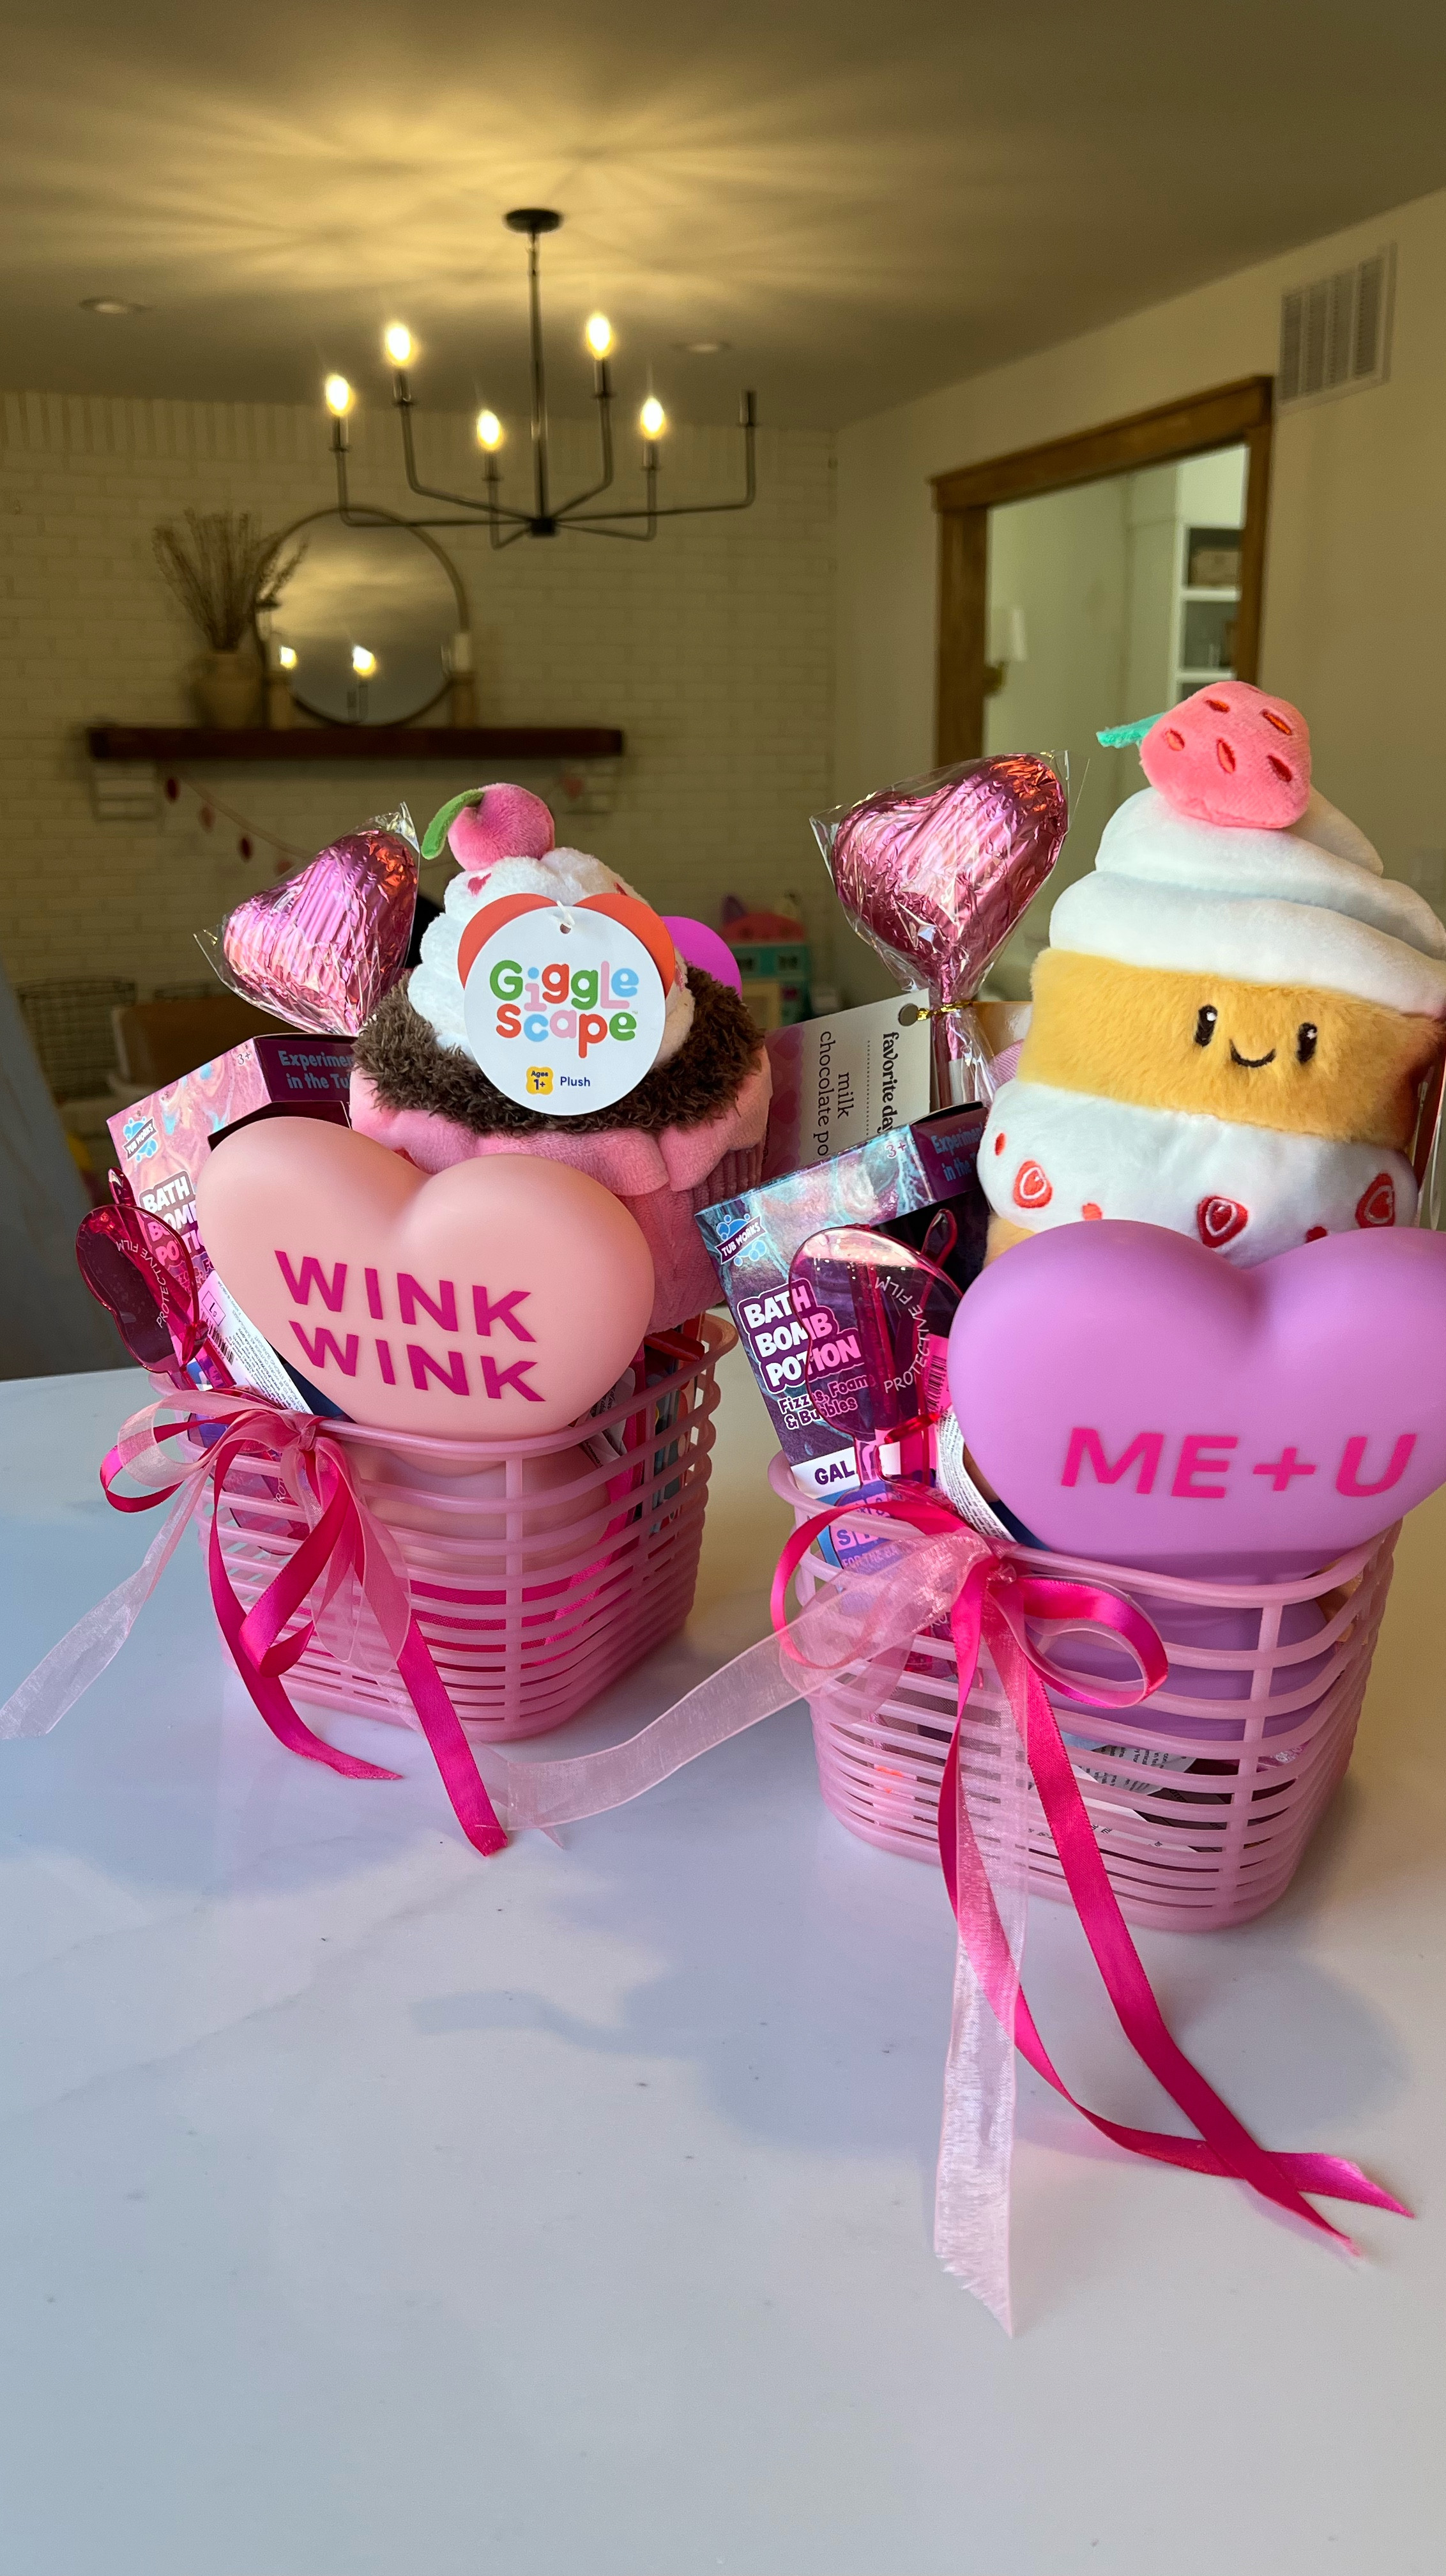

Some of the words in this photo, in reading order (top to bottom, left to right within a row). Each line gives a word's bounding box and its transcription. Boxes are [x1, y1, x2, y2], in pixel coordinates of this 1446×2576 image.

[237, 1052, 251, 1065] 3+
[531, 1070, 549, 1078] Ages
[882, 1032, 899, 1103] favorite
[286, 1073, 302, 1089] in
[304, 1072, 330, 1089] the
[330, 1073, 351, 1089] Tu
[533, 1079, 546, 1091] 1+
[560, 1076, 591, 1087] Plush
[818, 1031, 836, 1127] chocolate
[837, 1072, 855, 1119] milk
[813, 1130, 829, 1157] po
[886, 1142, 906, 1158] 3+
[941, 1162, 957, 1181] in
[953, 1157, 973, 1177] the
[142, 1176, 190, 1214] BATH
[116, 1239, 139, 1254] FILM
[721, 1241, 737, 1257] TUB
[735, 1222, 761, 1247] WORKS
[139, 1248, 170, 1329] PROTECTIVE
[274, 1250, 537, 1343] WINK
[874, 1276, 913, 1305] FILM
[743, 1285, 811, 1329] BATH
[755, 1312, 833, 1358] BOMB
[883, 1305, 931, 1394] PROTECTIVE
[288, 1320, 547, 1402] WINK
[765, 1335, 862, 1388] POTION
[784, 1414, 798, 1430] &
[814, 1460, 856, 1485] GAL
